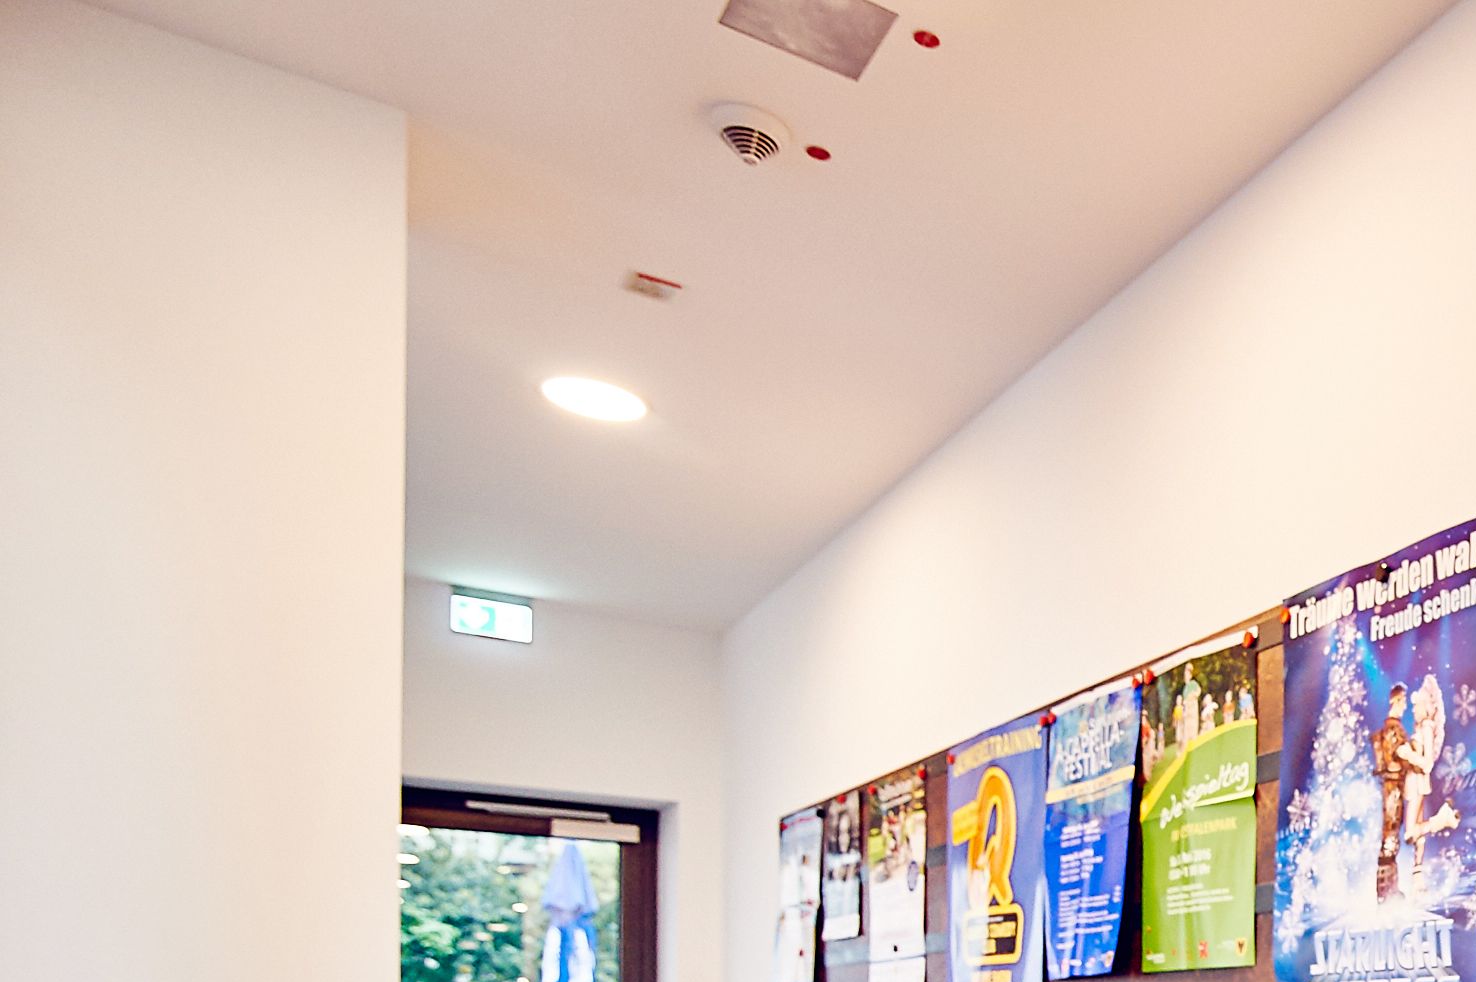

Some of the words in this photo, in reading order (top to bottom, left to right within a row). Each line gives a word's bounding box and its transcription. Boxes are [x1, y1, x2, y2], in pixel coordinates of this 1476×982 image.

[1289, 586, 1355, 640] Träume
[1356, 554, 1435, 612] werden
[1370, 602, 1423, 643] Freude
[1309, 918, 1454, 976] STARLIGHT
